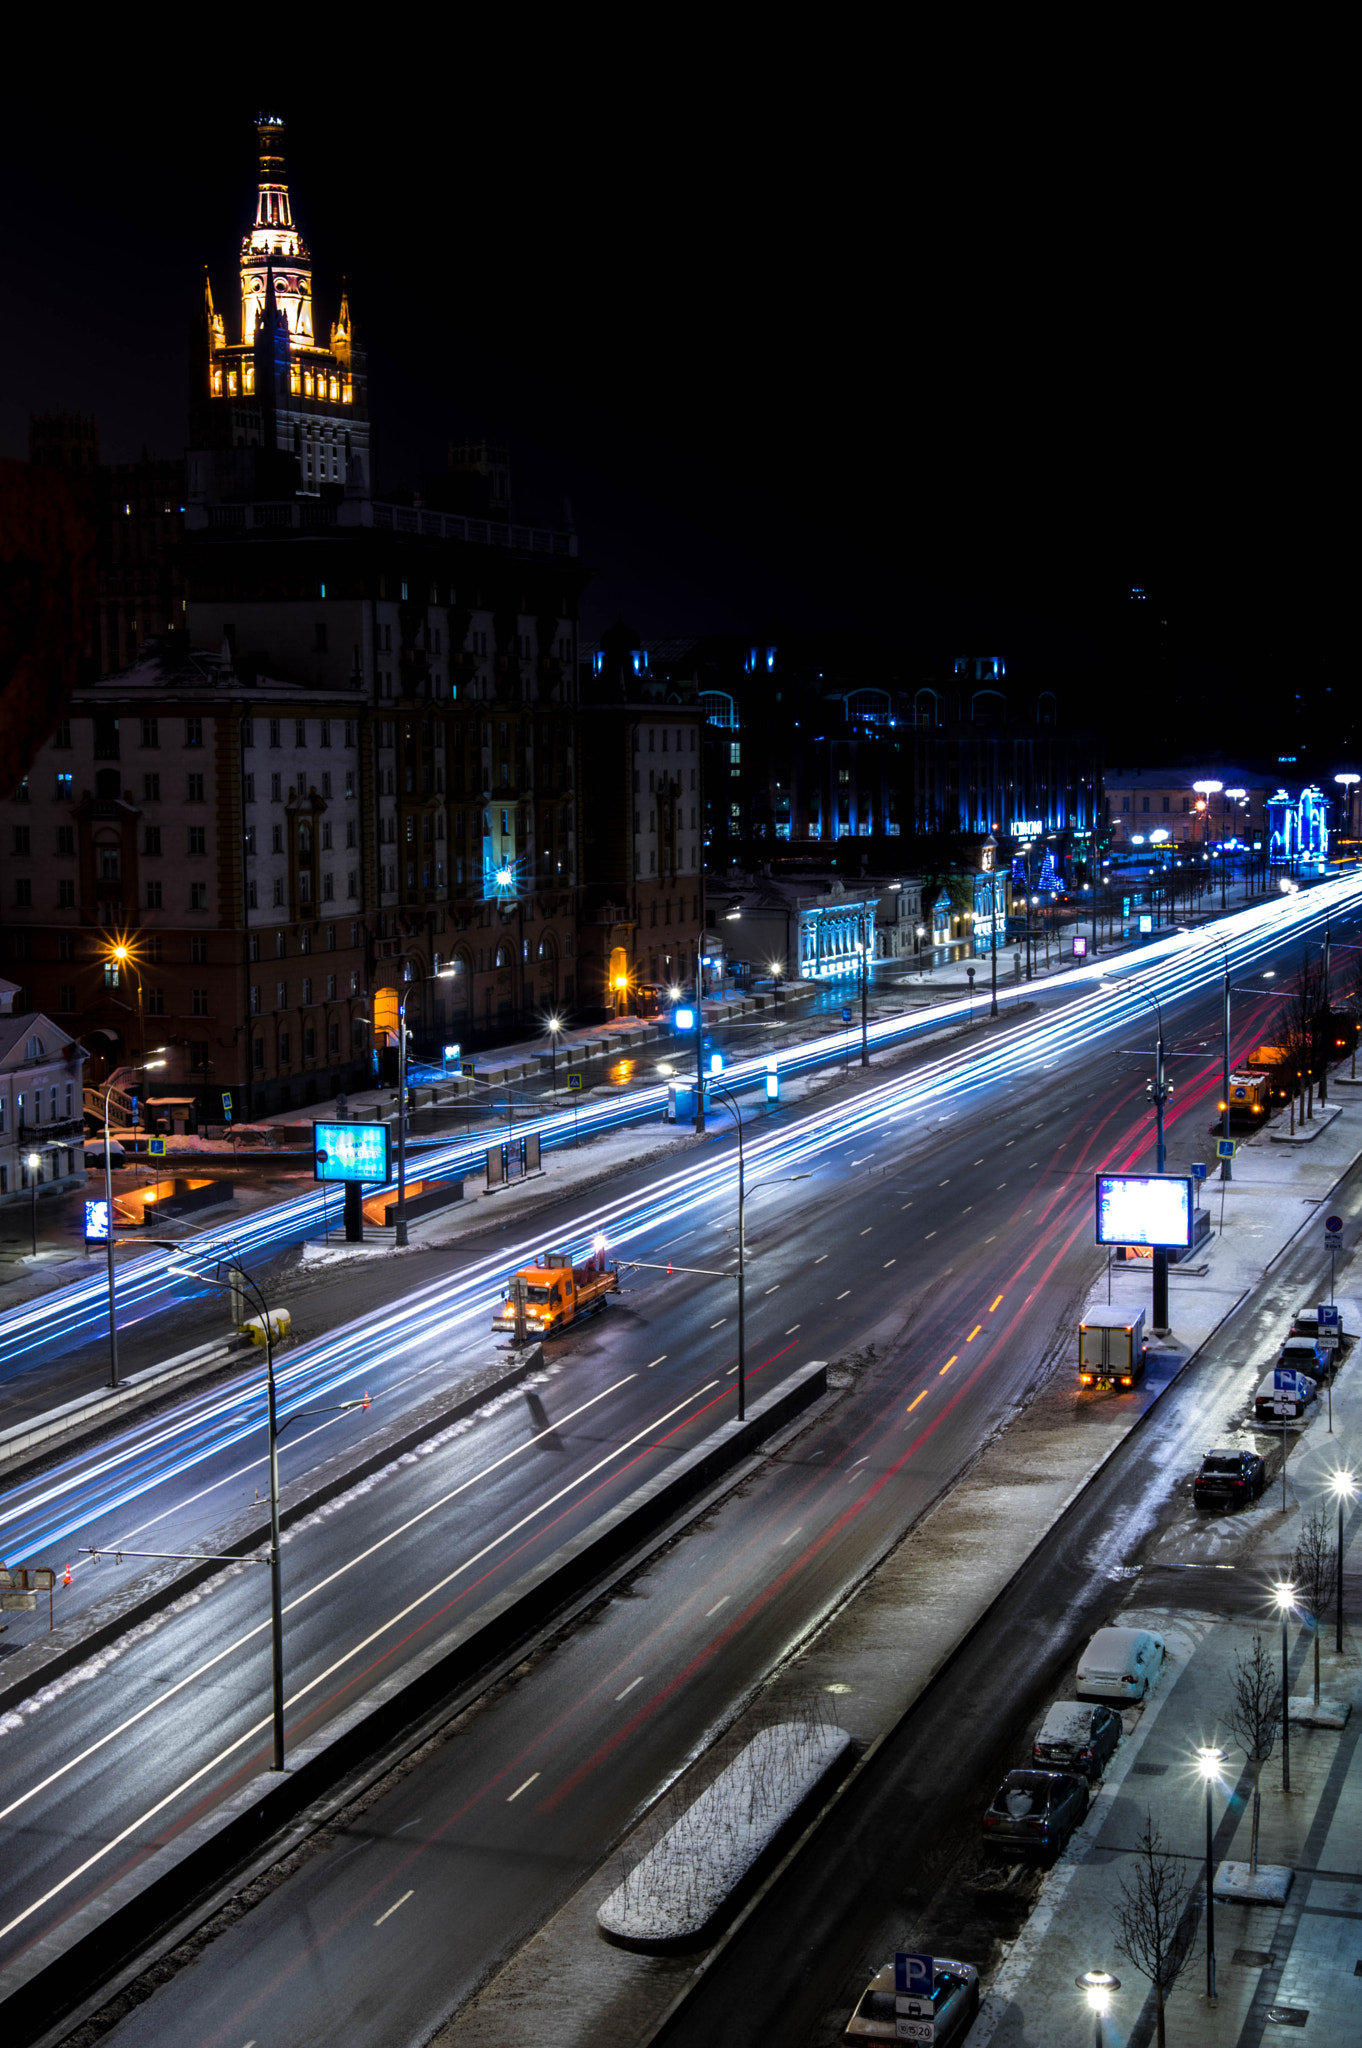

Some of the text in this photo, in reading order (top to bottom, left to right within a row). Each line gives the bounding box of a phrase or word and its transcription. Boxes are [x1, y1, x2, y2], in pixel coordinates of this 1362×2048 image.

[1322, 1308, 1334, 1323] P
[1280, 1370, 1293, 1388] P
[905, 1957, 927, 1989] P
[908, 2026, 916, 2034] 15
[918, 2026, 930, 2037] 20
